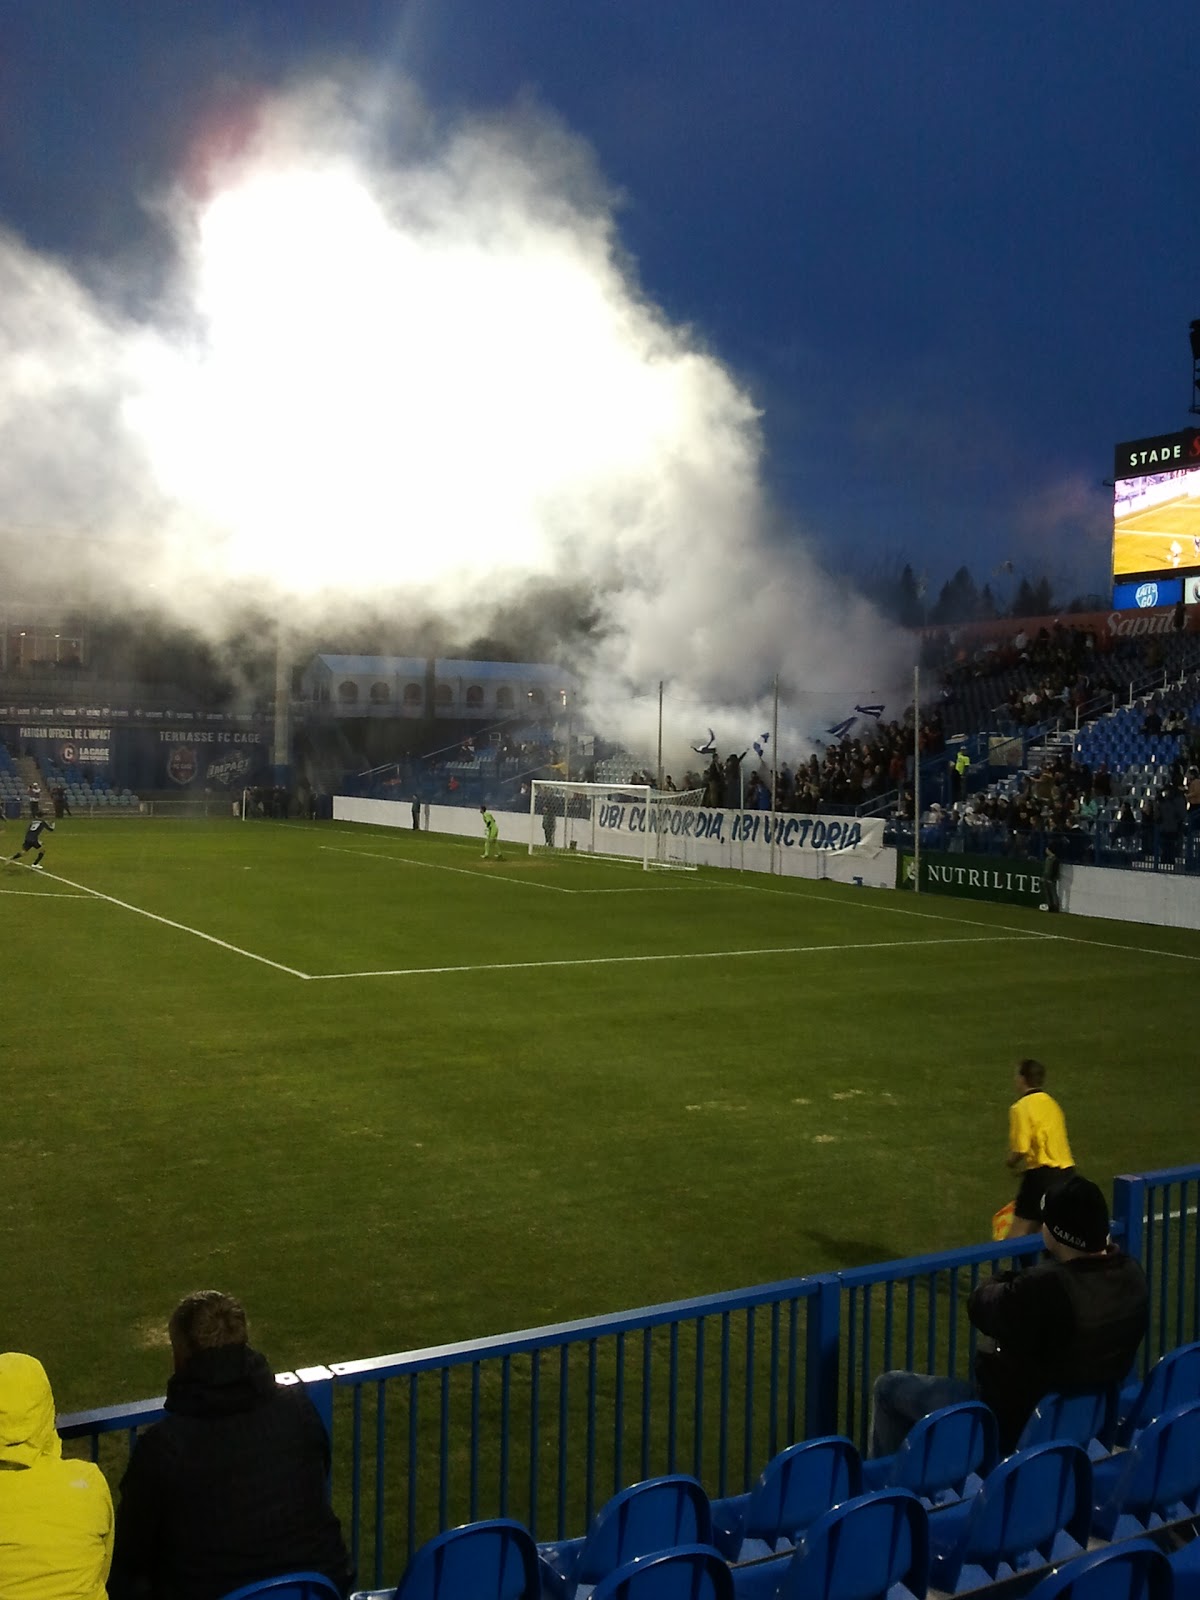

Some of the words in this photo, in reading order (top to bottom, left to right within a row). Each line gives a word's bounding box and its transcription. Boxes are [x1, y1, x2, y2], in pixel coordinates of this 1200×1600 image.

[1130, 445, 1181, 466] STADE
[160, 731, 215, 743] TERRASSE
[218, 733, 231, 743] FC
[233, 734, 261, 744] CAGE
[599, 804, 625, 830] UBI
[731, 813, 760, 842] IBI
[764, 817, 861, 850] VICTORIA
[927, 865, 1041, 895] NUTRILITE
[1053, 1225, 1086, 1248] CANADA
